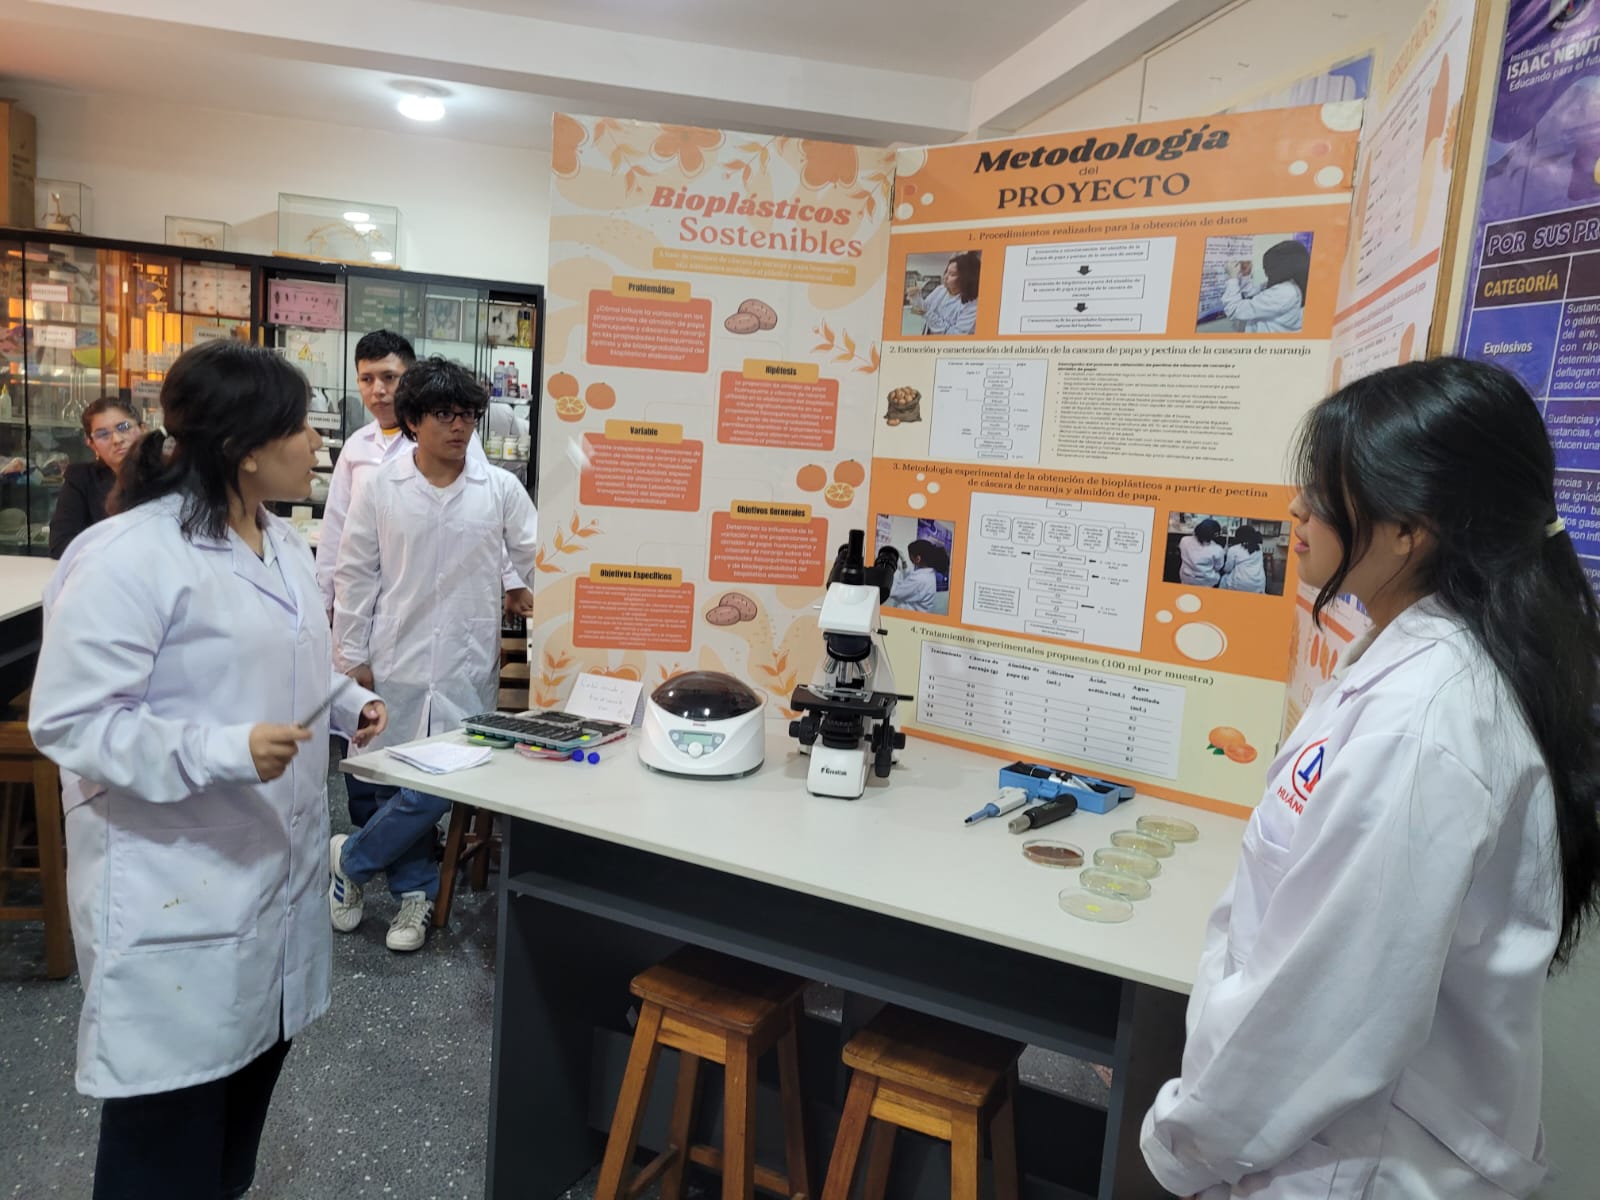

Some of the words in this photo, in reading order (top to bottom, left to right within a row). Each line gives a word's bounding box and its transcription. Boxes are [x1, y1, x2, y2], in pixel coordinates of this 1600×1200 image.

[1507, 52, 1551, 80] ISAAC
[1509, 71, 1551, 92] Educando
[1552, 64, 1573, 79] para
[1575, 59, 1584, 71] el
[973, 124, 1231, 174] Metodología
[1078, 166, 1099, 176] del
[997, 172, 1190, 210] PROYECTO
[650, 186, 851, 225] Bioplásticos
[679, 216, 863, 258] Sostenibles
[979, 228, 1051, 241] Procedimientos
[1052, 224, 1102, 236] realizados
[1104, 224, 1129, 235] para
[1130, 221, 1141, 232] la
[1142, 218, 1197, 230] obtención
[1199, 216, 1215, 227] de
[1217, 214, 1248, 225] datos
[1488, 230, 1527, 256] POR
[1533, 223, 1572, 249] SUS
[628, 282, 675, 295] Problemática
[1484, 270, 1559, 297] CATEGORÍA
[1562, 329, 1576, 339] del
[1578, 328, 1598, 339] aire,
[1001, 345, 1013, 354] del
[1050, 345, 1062, 354] de
[1062, 345, 1070, 354] la
[1106, 346, 1118, 354] de
[1119, 348, 1142, 356] papa
[1151, 346, 1186, 356] pectina
[1188, 346, 1200, 355] de
[1203, 346, 1212, 355] la
[1253, 346, 1267, 355] de
[1269, 346, 1311, 356] naranja
[1483, 341, 1533, 357] Explosivos
[1560, 343, 1577, 352] con
[765, 365, 797, 376] Hipótesis
[1556, 366, 1595, 380] deflagran
[1554, 381, 1573, 390] caso
[1574, 379, 1585, 390] de
[630, 426, 658, 436] Variable
[902, 463, 952, 476] Metodología
[954, 467, 1011, 479] experimental
[1014, 471, 1024, 480] de
[1026, 471, 1035, 481] la
[1037, 473, 1084, 485] obtención
[1087, 476, 1099, 485] de
[1101, 477, 1163, 491] bioplásticos
[1174, 484, 1205, 493] partir
[1208, 486, 1223, 495] de
[1225, 487, 1268, 498] pectina
[967, 478, 979, 487] de
[980, 479, 1013, 489] cáscara
[1014, 481, 1026, 490] de
[1028, 484, 1063, 494] naranja
[1074, 486, 1114, 498] almidón
[1117, 489, 1130, 499] de
[737, 505, 768, 515] Objetivos
[920, 627, 976, 644] Tratamientos
[977, 638, 1045, 656] experimentales
[1046, 649, 1099, 665] propuestos
[1101, 658, 1126, 671] (100
[1128, 663, 1142, 673] ml
[1143, 667, 1162, 677] por
[1165, 671, 1215, 686] muestra)
